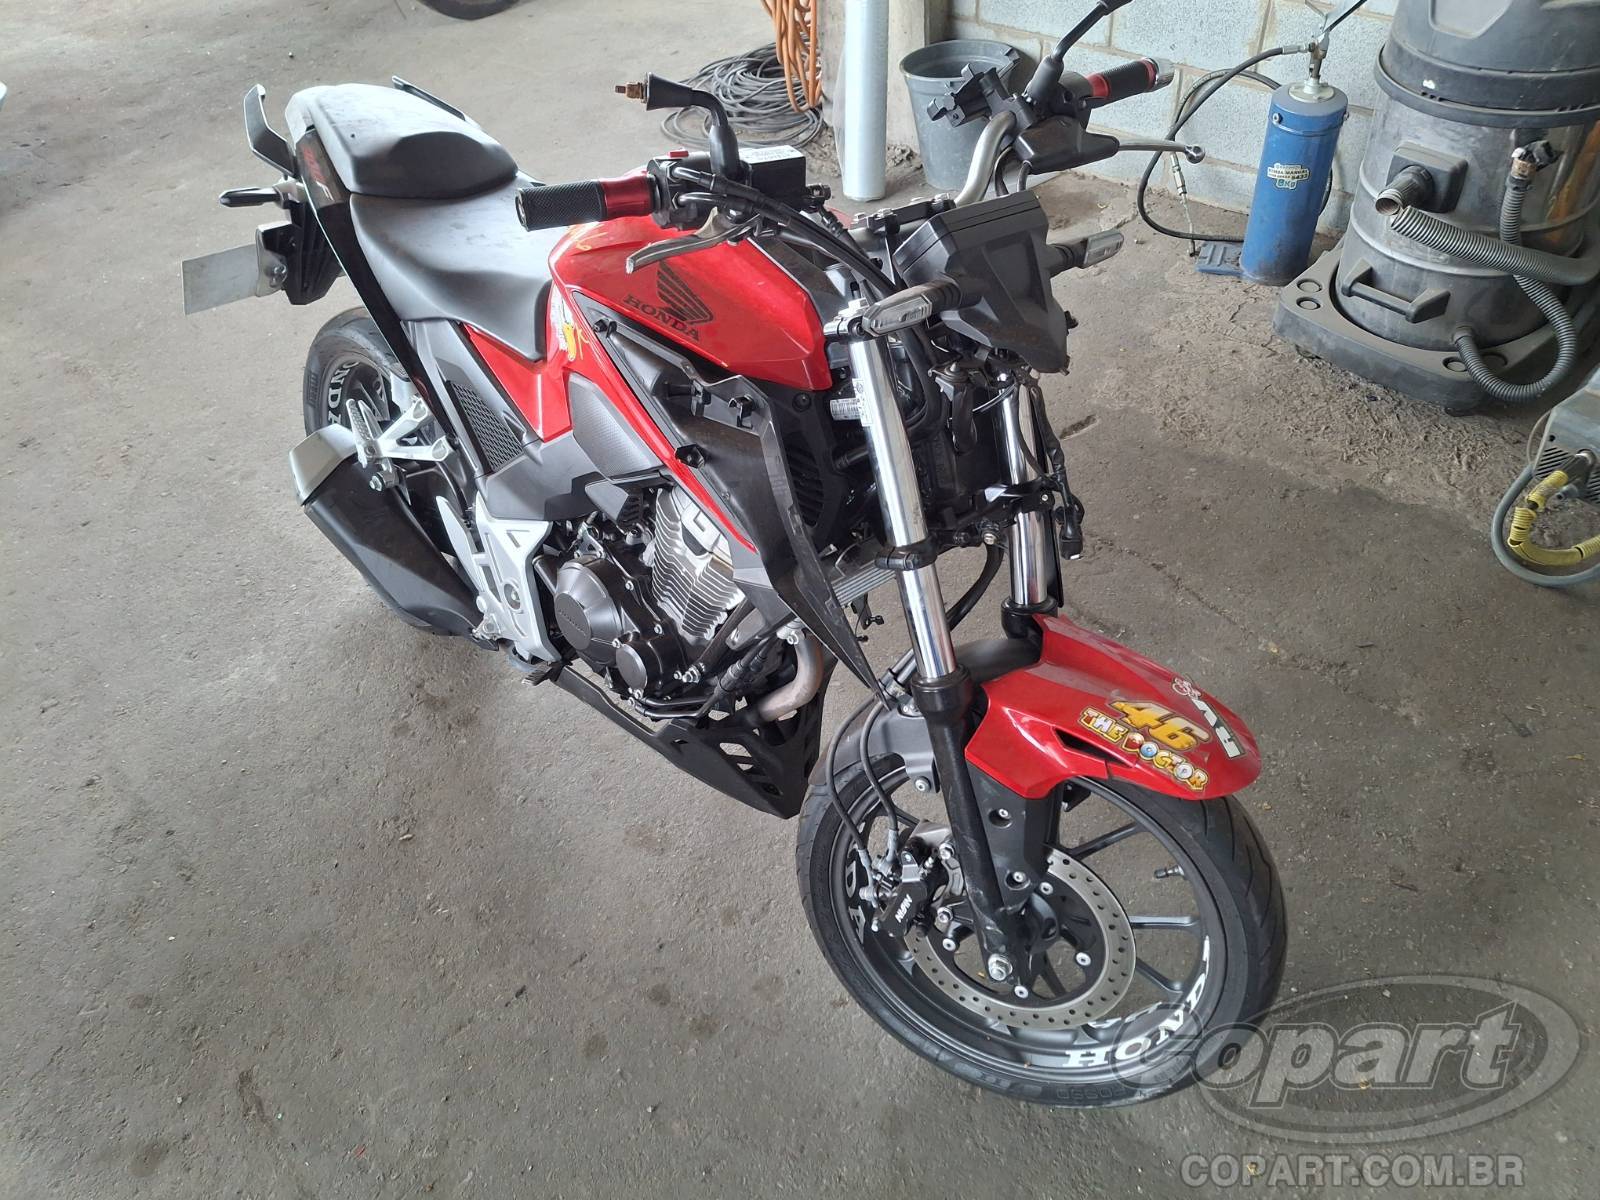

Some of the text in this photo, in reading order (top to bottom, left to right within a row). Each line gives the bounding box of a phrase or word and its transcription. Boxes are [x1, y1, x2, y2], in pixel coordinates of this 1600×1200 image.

[623, 294, 700, 342] HONDA
[327, 361, 361, 425] ONDA
[1079, 708, 1129, 743] THE
[1109, 700, 1211, 750] 46
